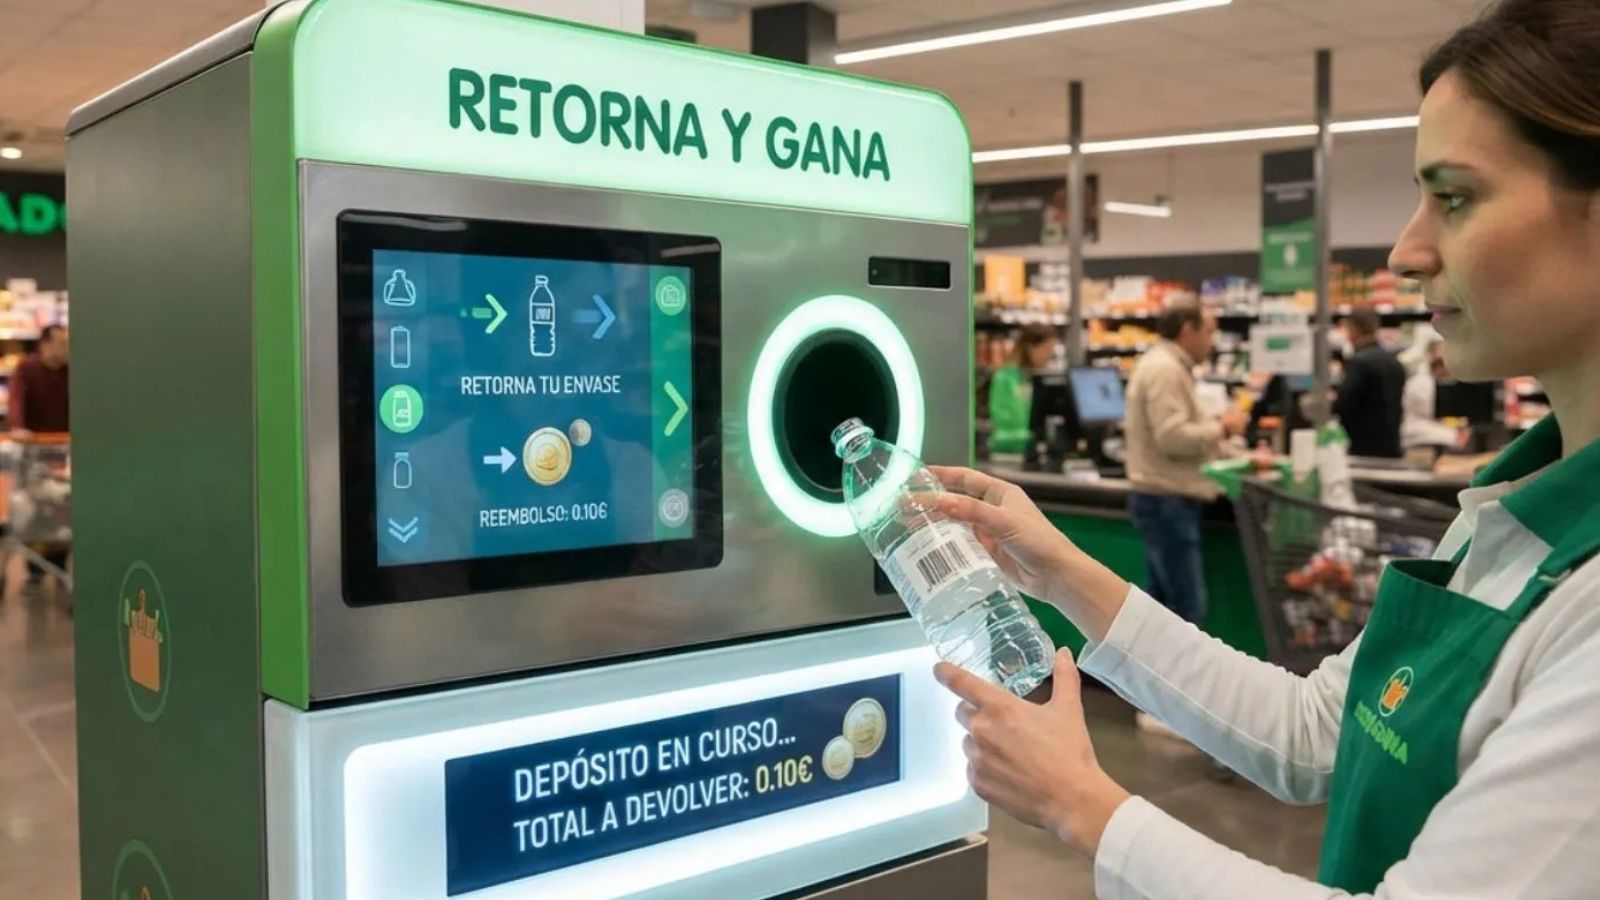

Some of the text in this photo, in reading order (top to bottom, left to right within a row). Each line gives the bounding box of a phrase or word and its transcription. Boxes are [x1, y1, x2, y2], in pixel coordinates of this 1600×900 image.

[449, 67, 891, 182] RETORNA Y GANA
[460, 375, 622, 395] RETORNA TU ENVASE
[479, 504, 569, 528] REEMBOLSO:
[514, 717, 797, 803] DEPÓSITO EN CURSO...
[513, 755, 814, 852] TOTAL A DEVOLVER: 0.10€
